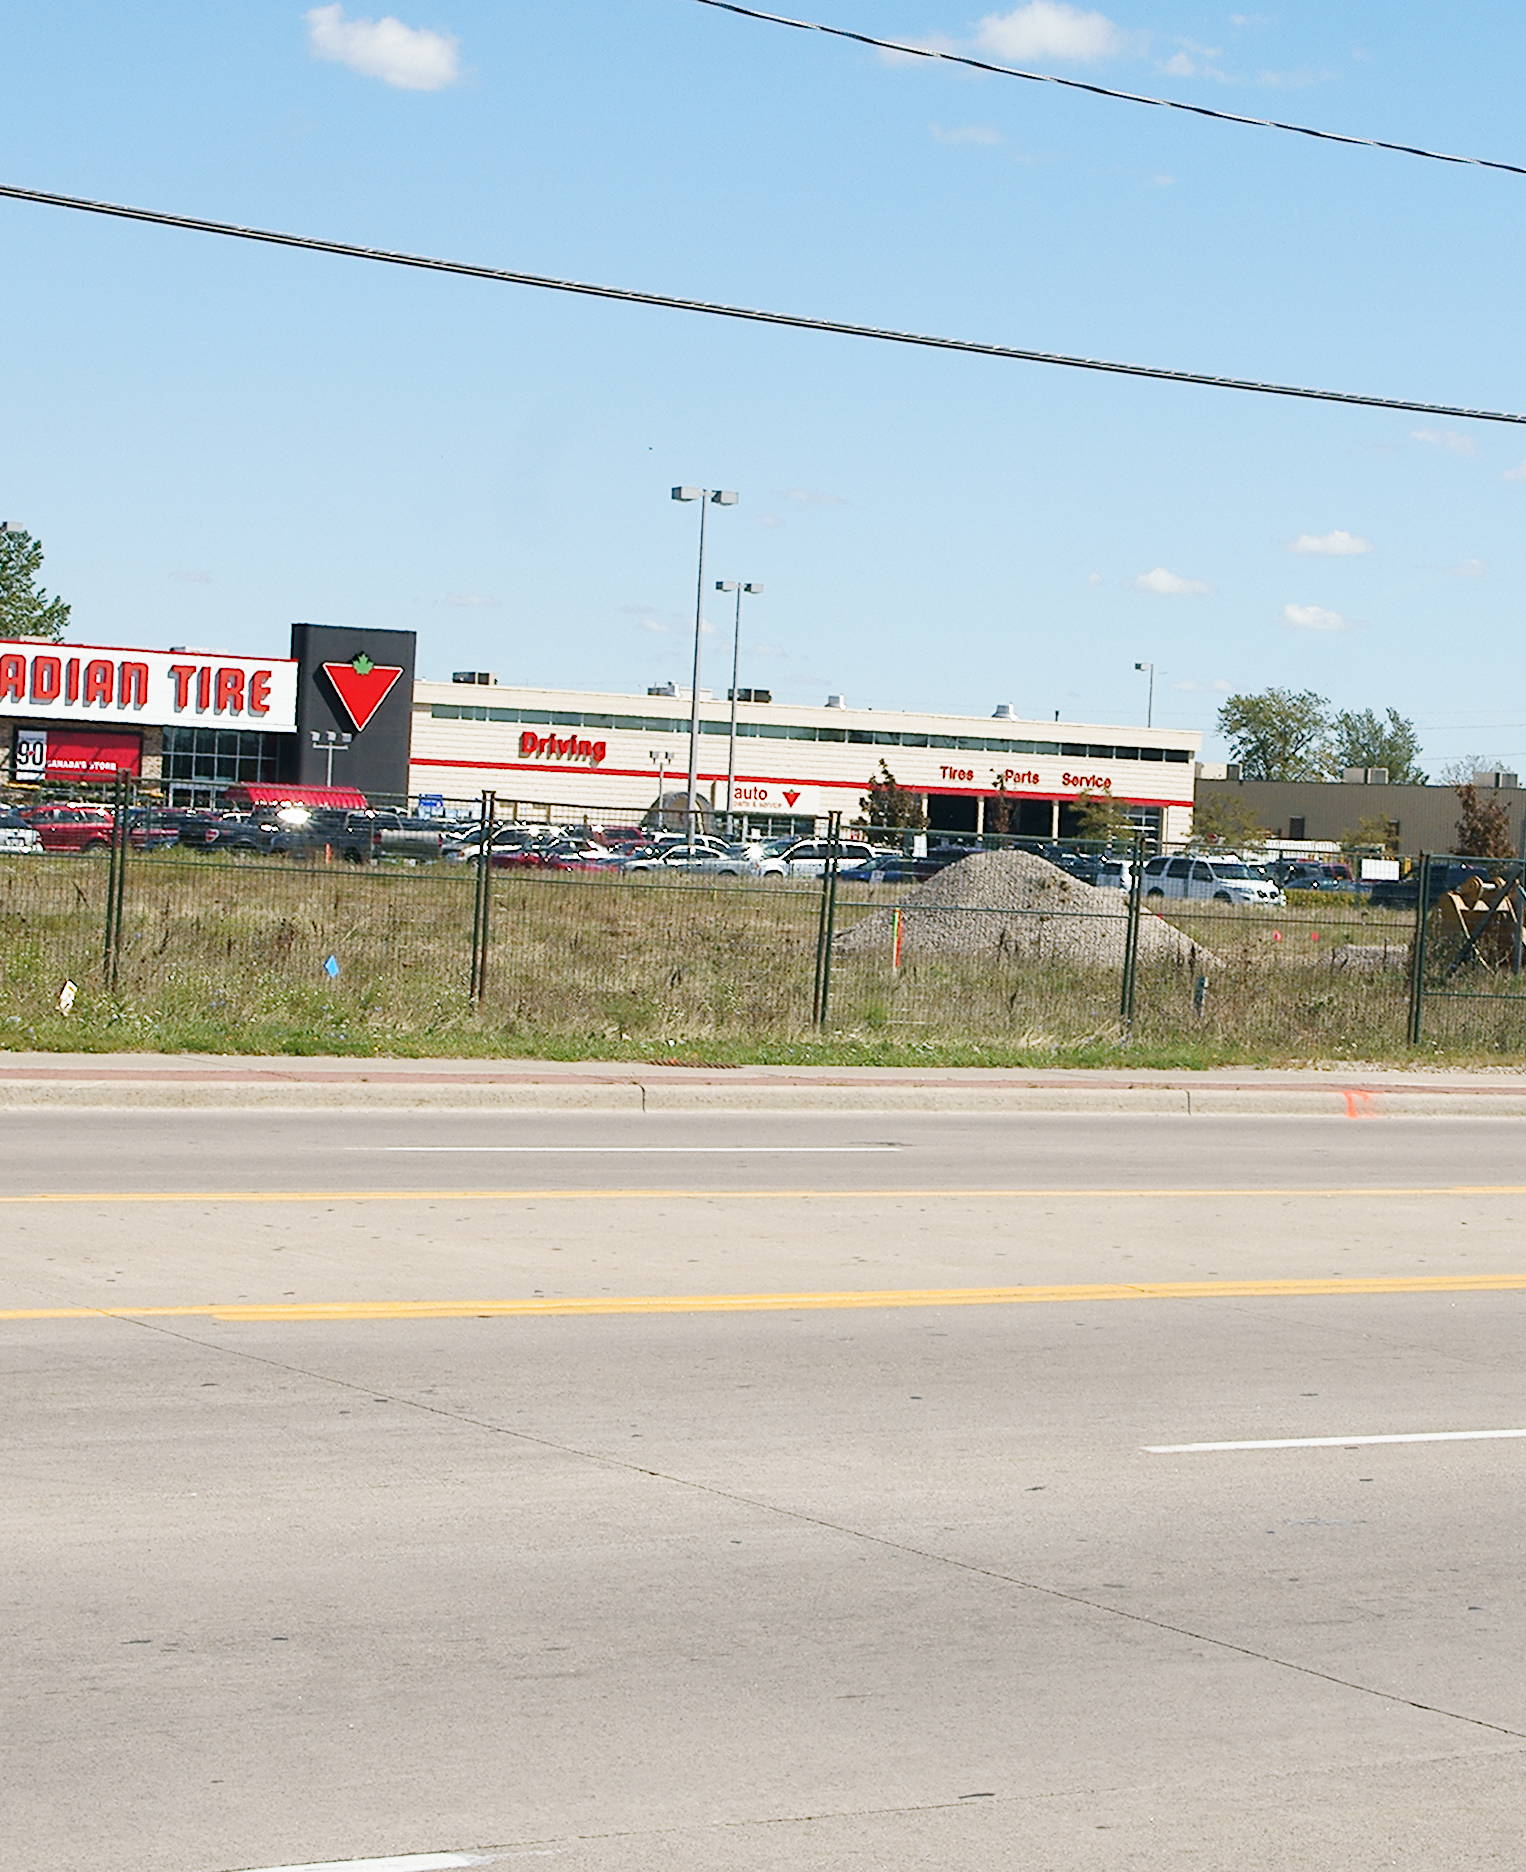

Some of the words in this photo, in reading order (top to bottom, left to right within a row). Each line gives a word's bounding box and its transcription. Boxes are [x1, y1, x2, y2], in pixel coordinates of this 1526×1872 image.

[170, 665, 272, 713] TIRE
[520, 731, 606, 763] Driving
[940, 766, 974, 781] Tires
[1005, 769, 1040, 785] Parts
[1062, 772, 1112, 789] Service
[734, 786, 768, 801] auto
